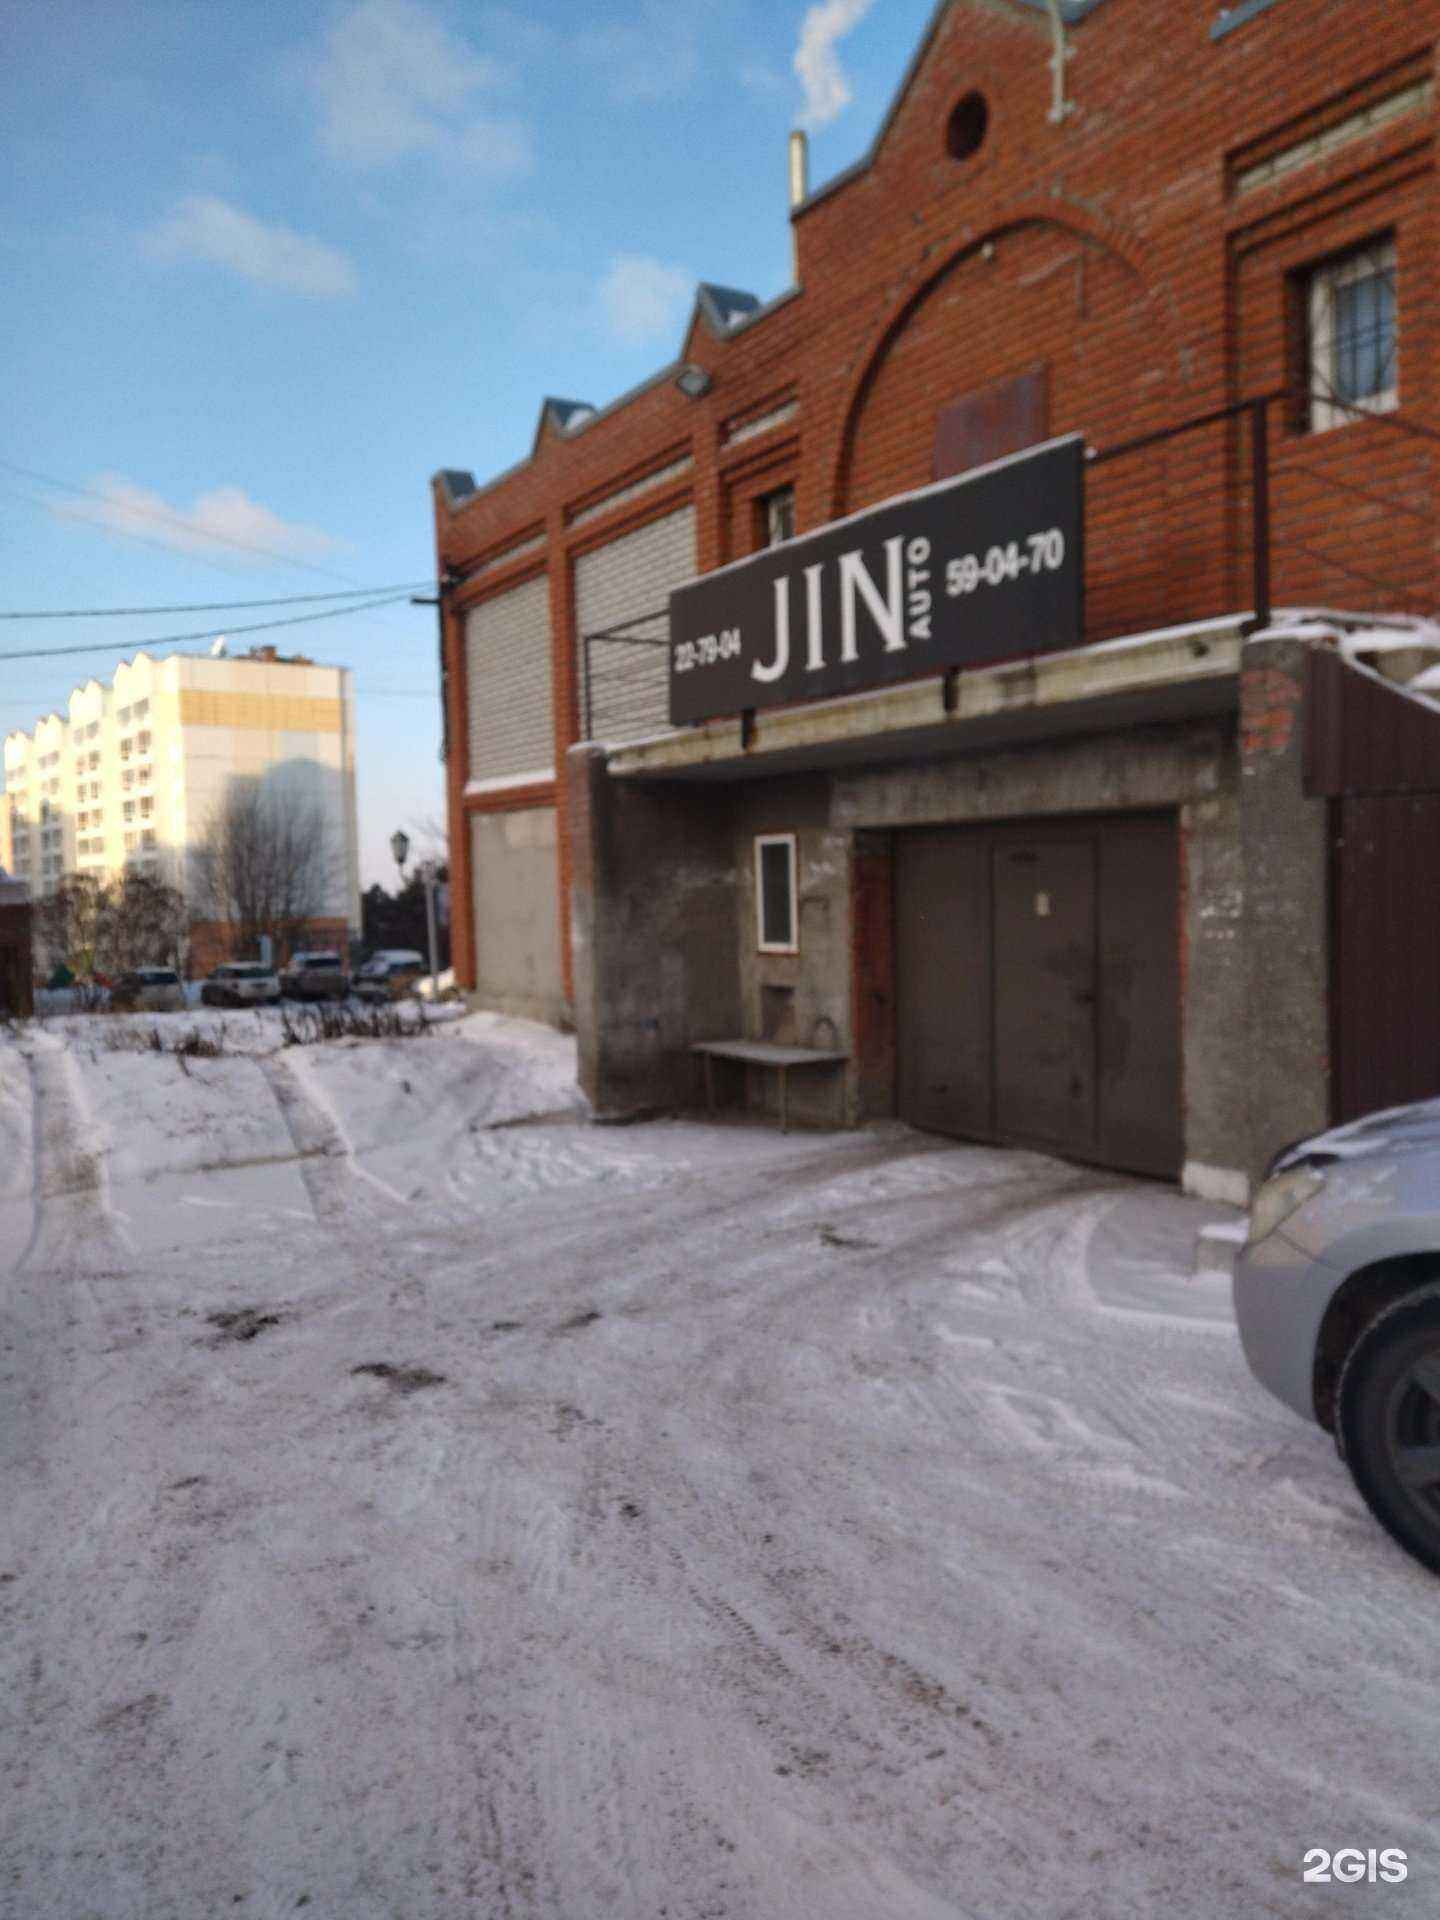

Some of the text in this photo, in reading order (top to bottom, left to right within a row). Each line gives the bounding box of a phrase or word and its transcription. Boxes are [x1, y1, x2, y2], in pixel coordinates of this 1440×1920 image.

[750, 533, 908, 684] JIN
[909, 535, 933, 641] AUTO
[945, 527, 1065, 597] 59-04-70
